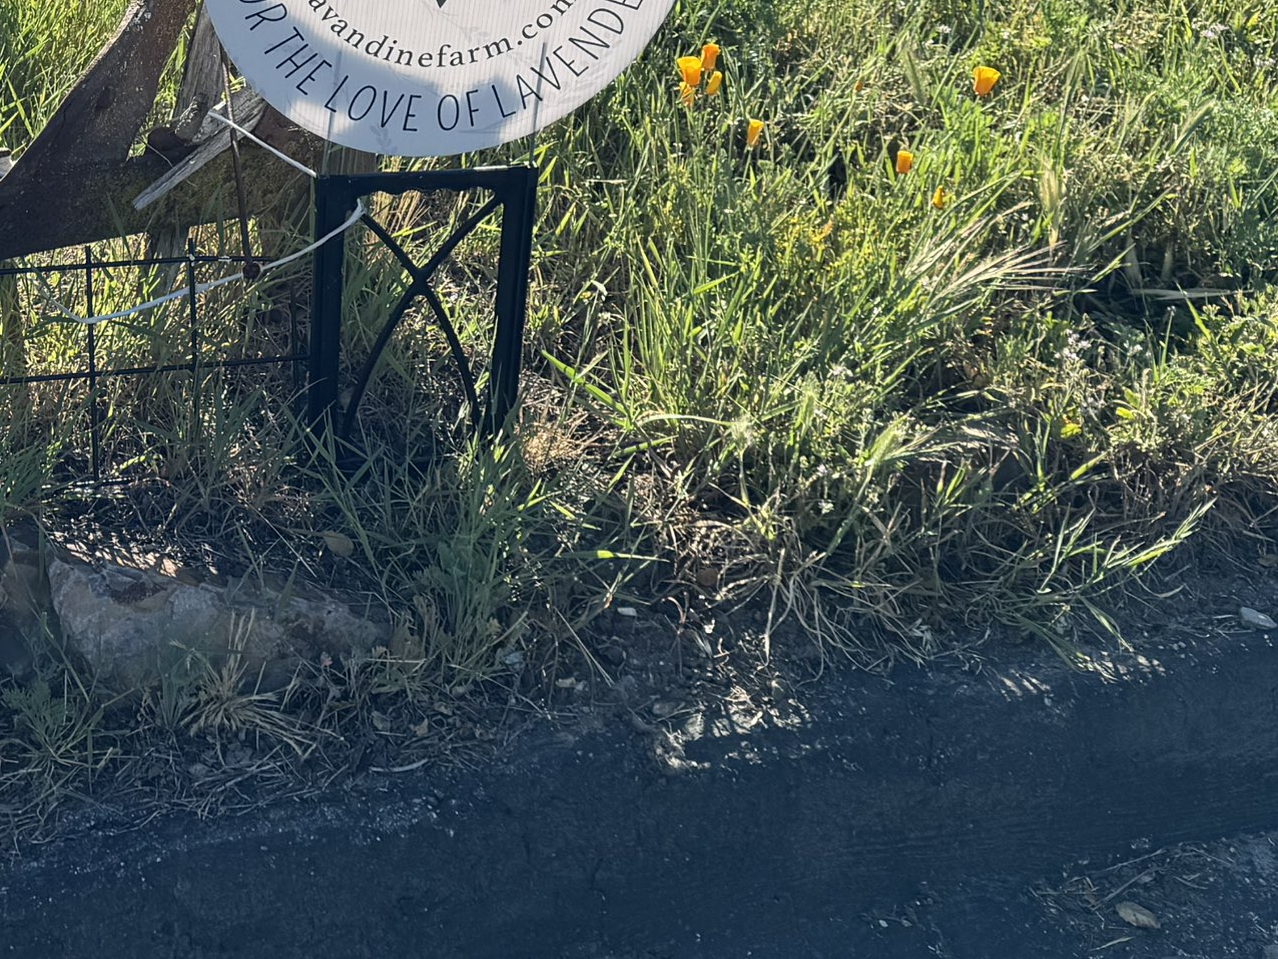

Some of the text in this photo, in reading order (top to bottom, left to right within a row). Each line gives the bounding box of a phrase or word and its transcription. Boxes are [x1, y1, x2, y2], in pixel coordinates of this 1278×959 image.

[264, 26, 333, 96] THE
[323, 75, 422, 132] LOVE
[437, 88, 480, 131] OF
